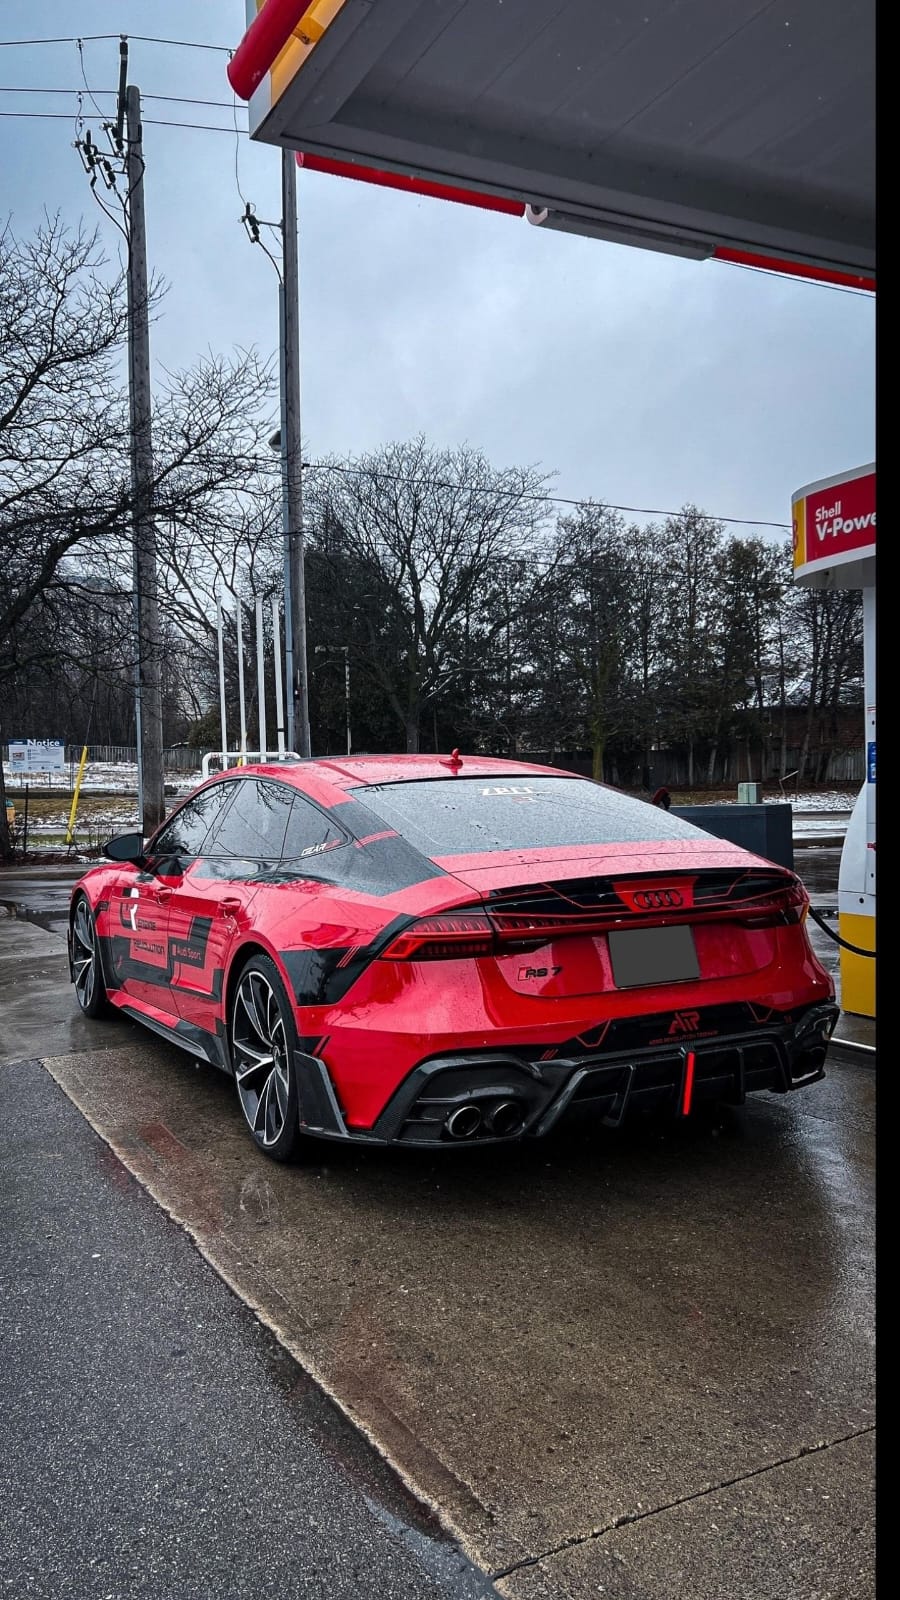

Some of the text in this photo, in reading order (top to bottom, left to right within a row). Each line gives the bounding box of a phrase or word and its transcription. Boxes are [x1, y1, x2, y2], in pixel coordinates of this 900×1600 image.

[815, 500, 842, 522] Shell
[27, 739, 60, 747] Notice
[525, 966, 563, 978] RS 7
